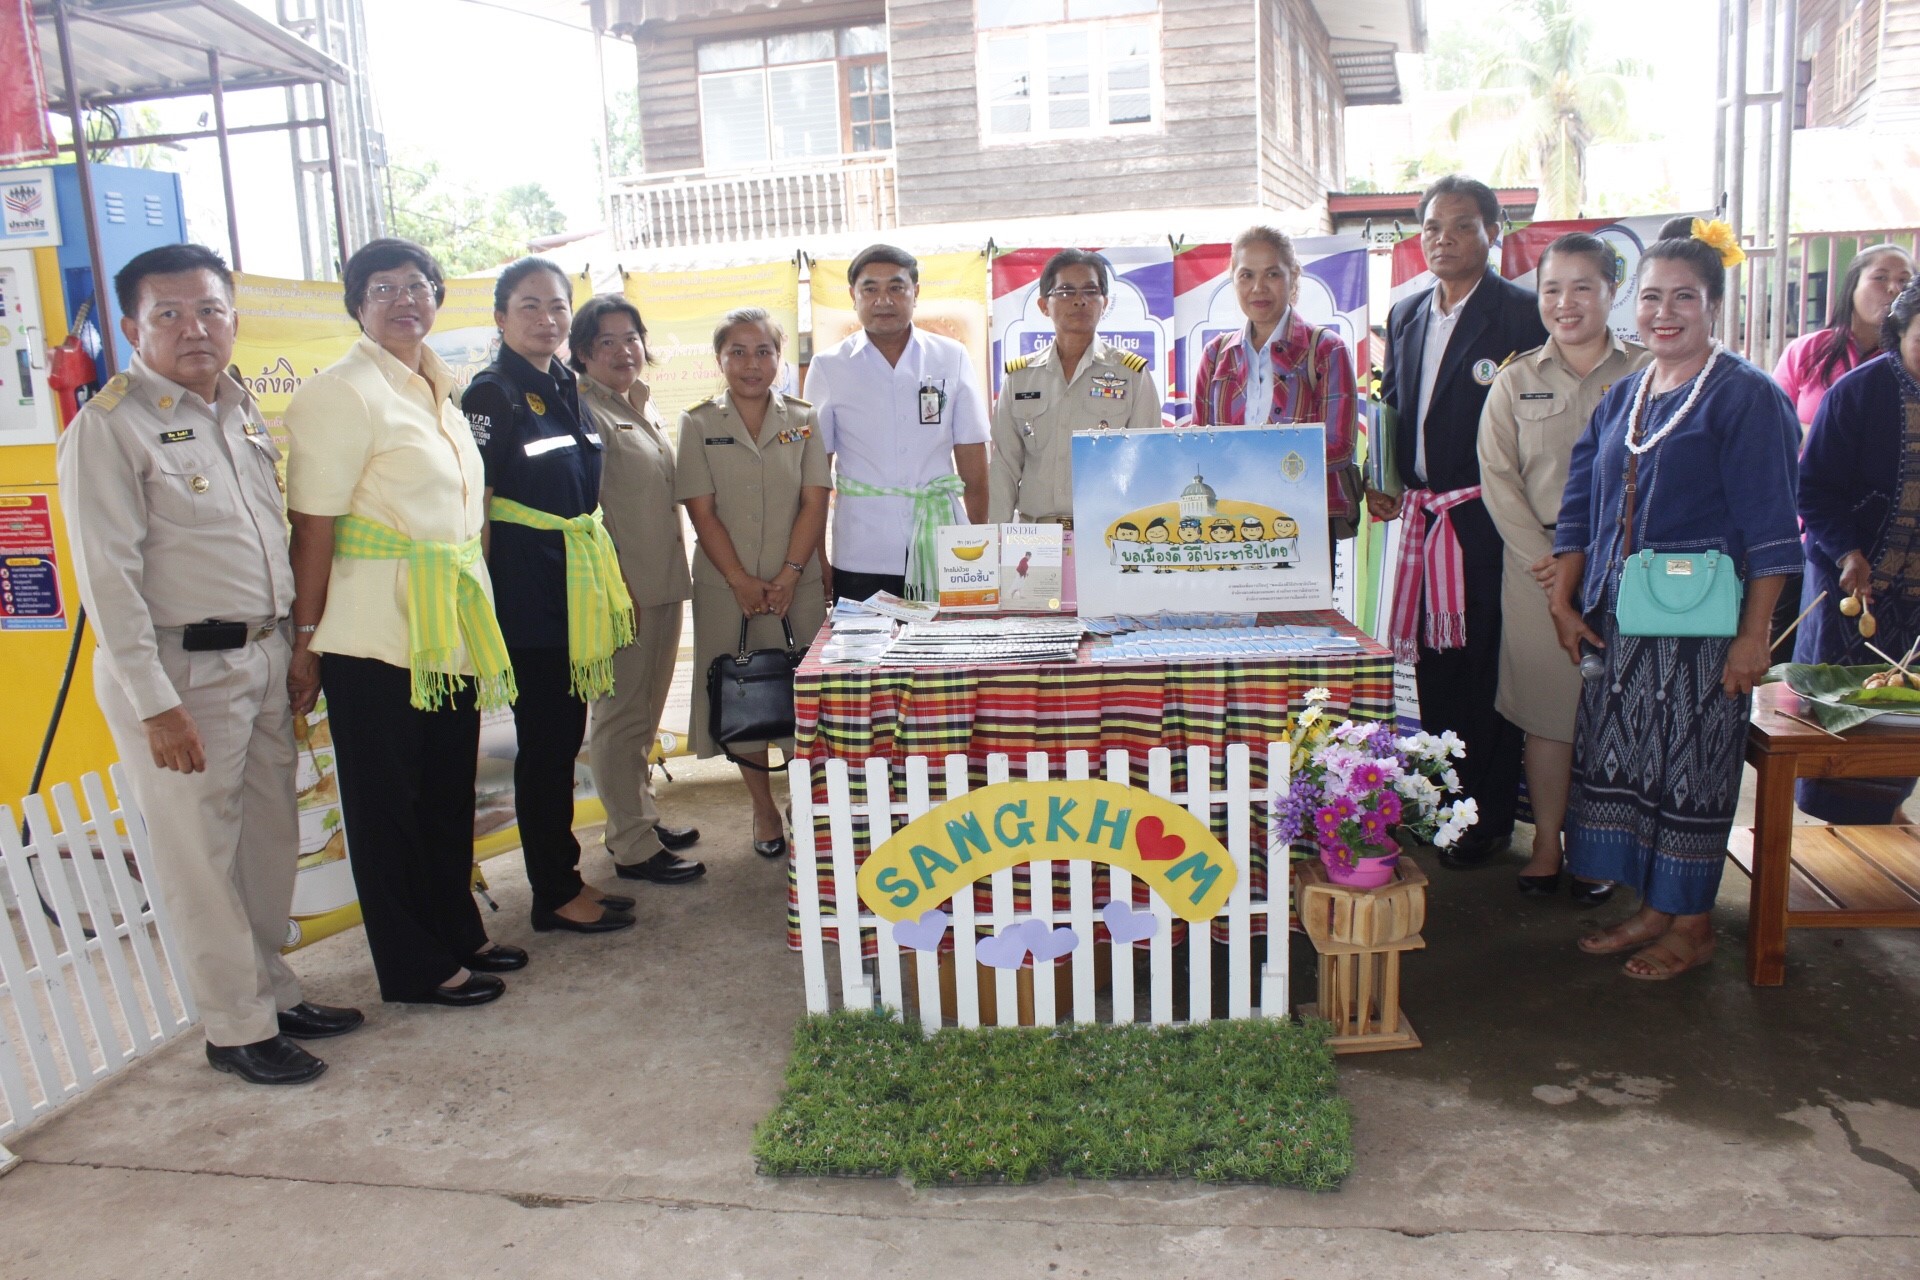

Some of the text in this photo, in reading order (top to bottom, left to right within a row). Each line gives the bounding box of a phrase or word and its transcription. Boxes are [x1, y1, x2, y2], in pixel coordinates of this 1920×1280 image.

[1121, 544, 1288, 563] พลเมืองดี วิถีประชาธิปไตย
